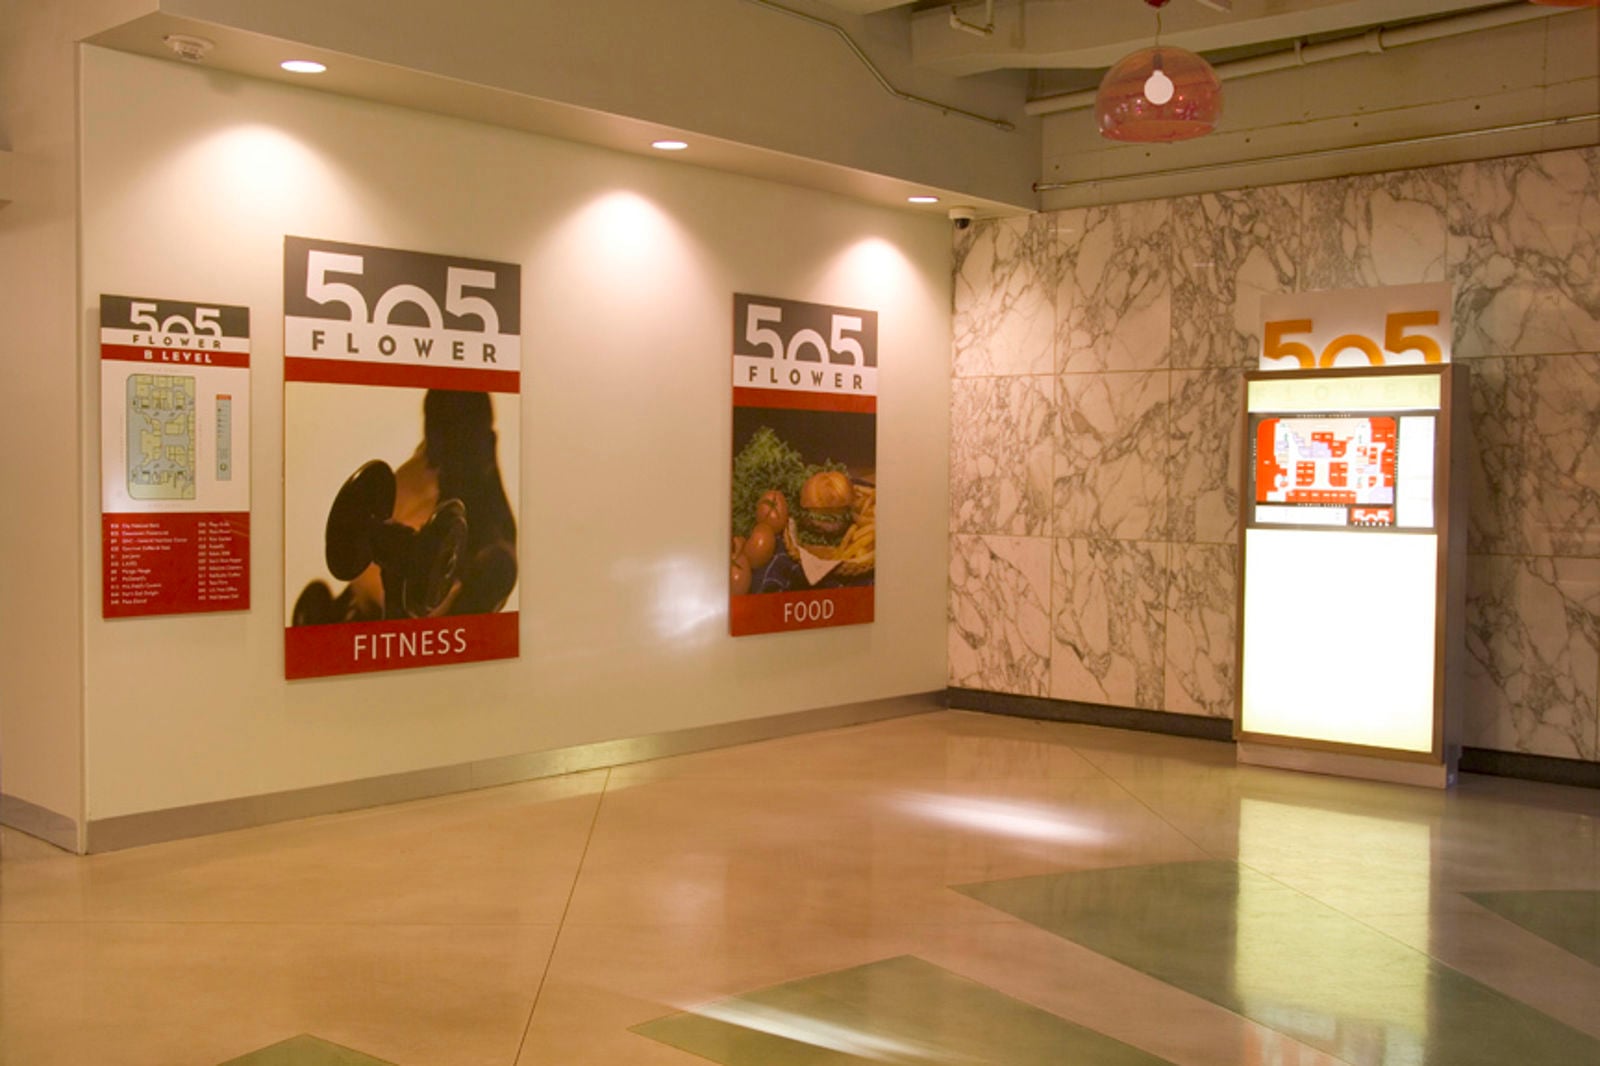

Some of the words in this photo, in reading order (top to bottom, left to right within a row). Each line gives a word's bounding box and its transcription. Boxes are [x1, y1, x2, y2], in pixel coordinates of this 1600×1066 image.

[306, 250, 499, 333] 505
[130, 301, 223, 337] 505
[746, 304, 864, 366] 505
[133, 334, 221, 349] FLOWER
[312, 330, 497, 363] FLOWER
[1263, 310, 1442, 369] 505
[162, 350, 212, 363] LEVEL
[749, 366, 862, 389] FLOWER
[784, 599, 834, 623] FOOD
[354, 628, 467, 660] FITNESS
